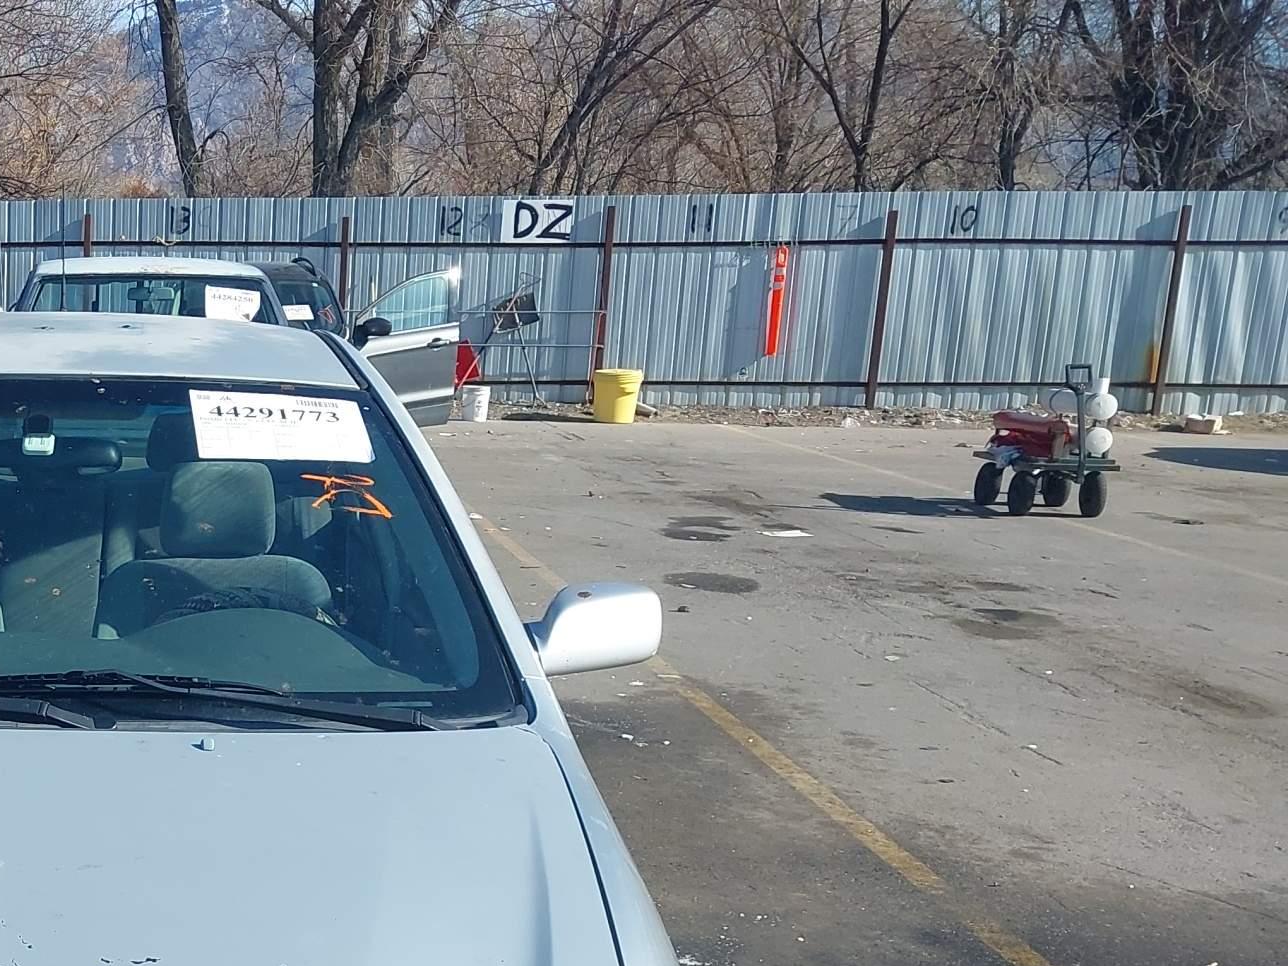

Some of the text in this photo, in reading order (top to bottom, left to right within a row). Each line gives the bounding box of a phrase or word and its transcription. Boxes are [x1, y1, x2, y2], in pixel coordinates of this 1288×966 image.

[170, 205, 191, 235] 13
[440, 205, 463, 236] 12
[513, 201, 573, 241] DZ
[691, 203, 713, 234] 11
[950, 204, 977, 235] 10
[208, 405, 340, 423] 44291773
